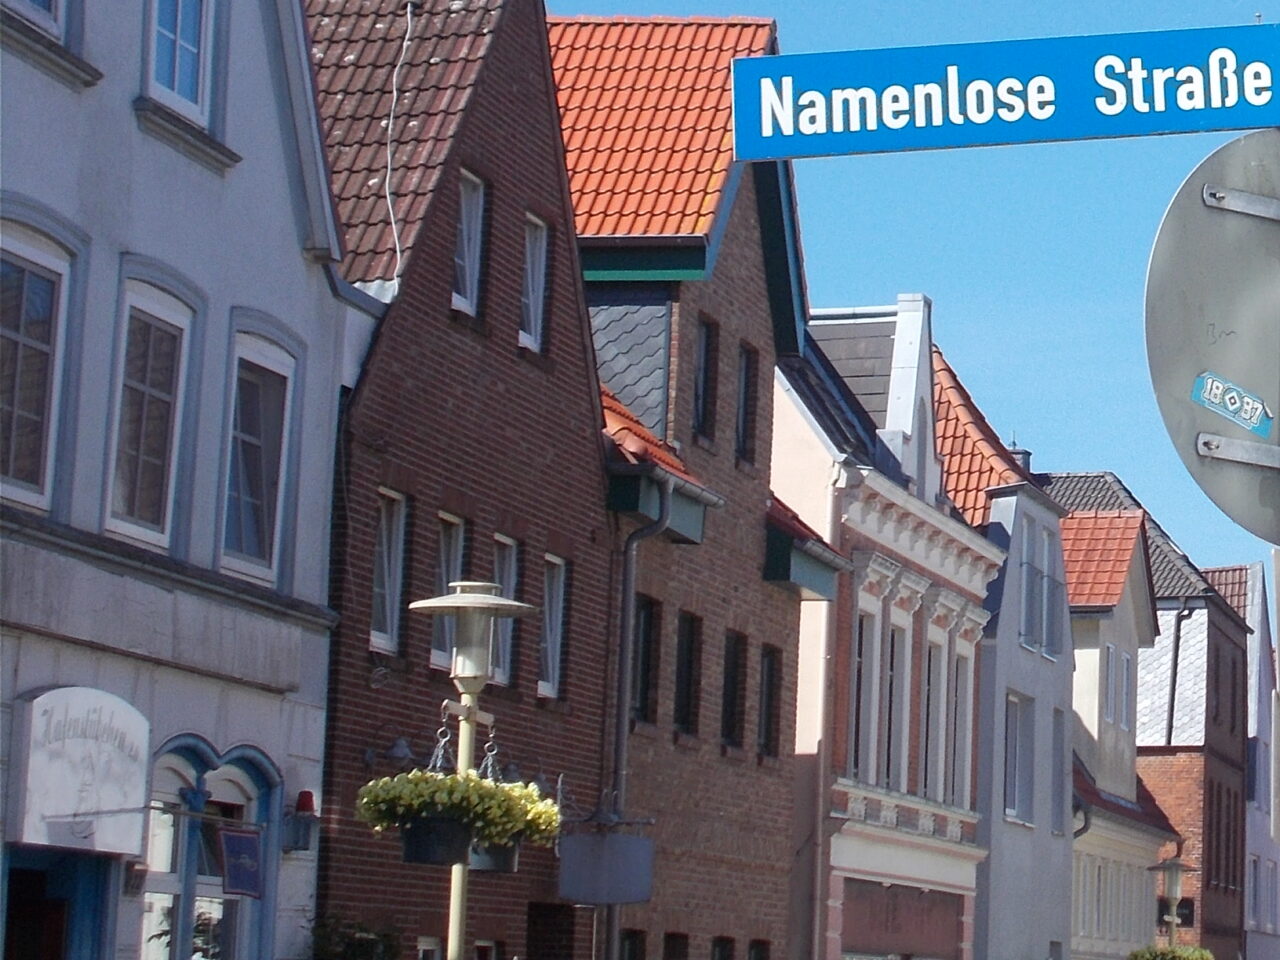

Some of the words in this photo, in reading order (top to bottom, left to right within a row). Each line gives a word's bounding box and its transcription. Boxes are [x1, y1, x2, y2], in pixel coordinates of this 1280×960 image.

[760, 65, 1056, 137] Namenlose
[1094, 47, 1273, 115] Straße
[1202, 377, 1224, 405] 18
[1239, 394, 1264, 426] 87
